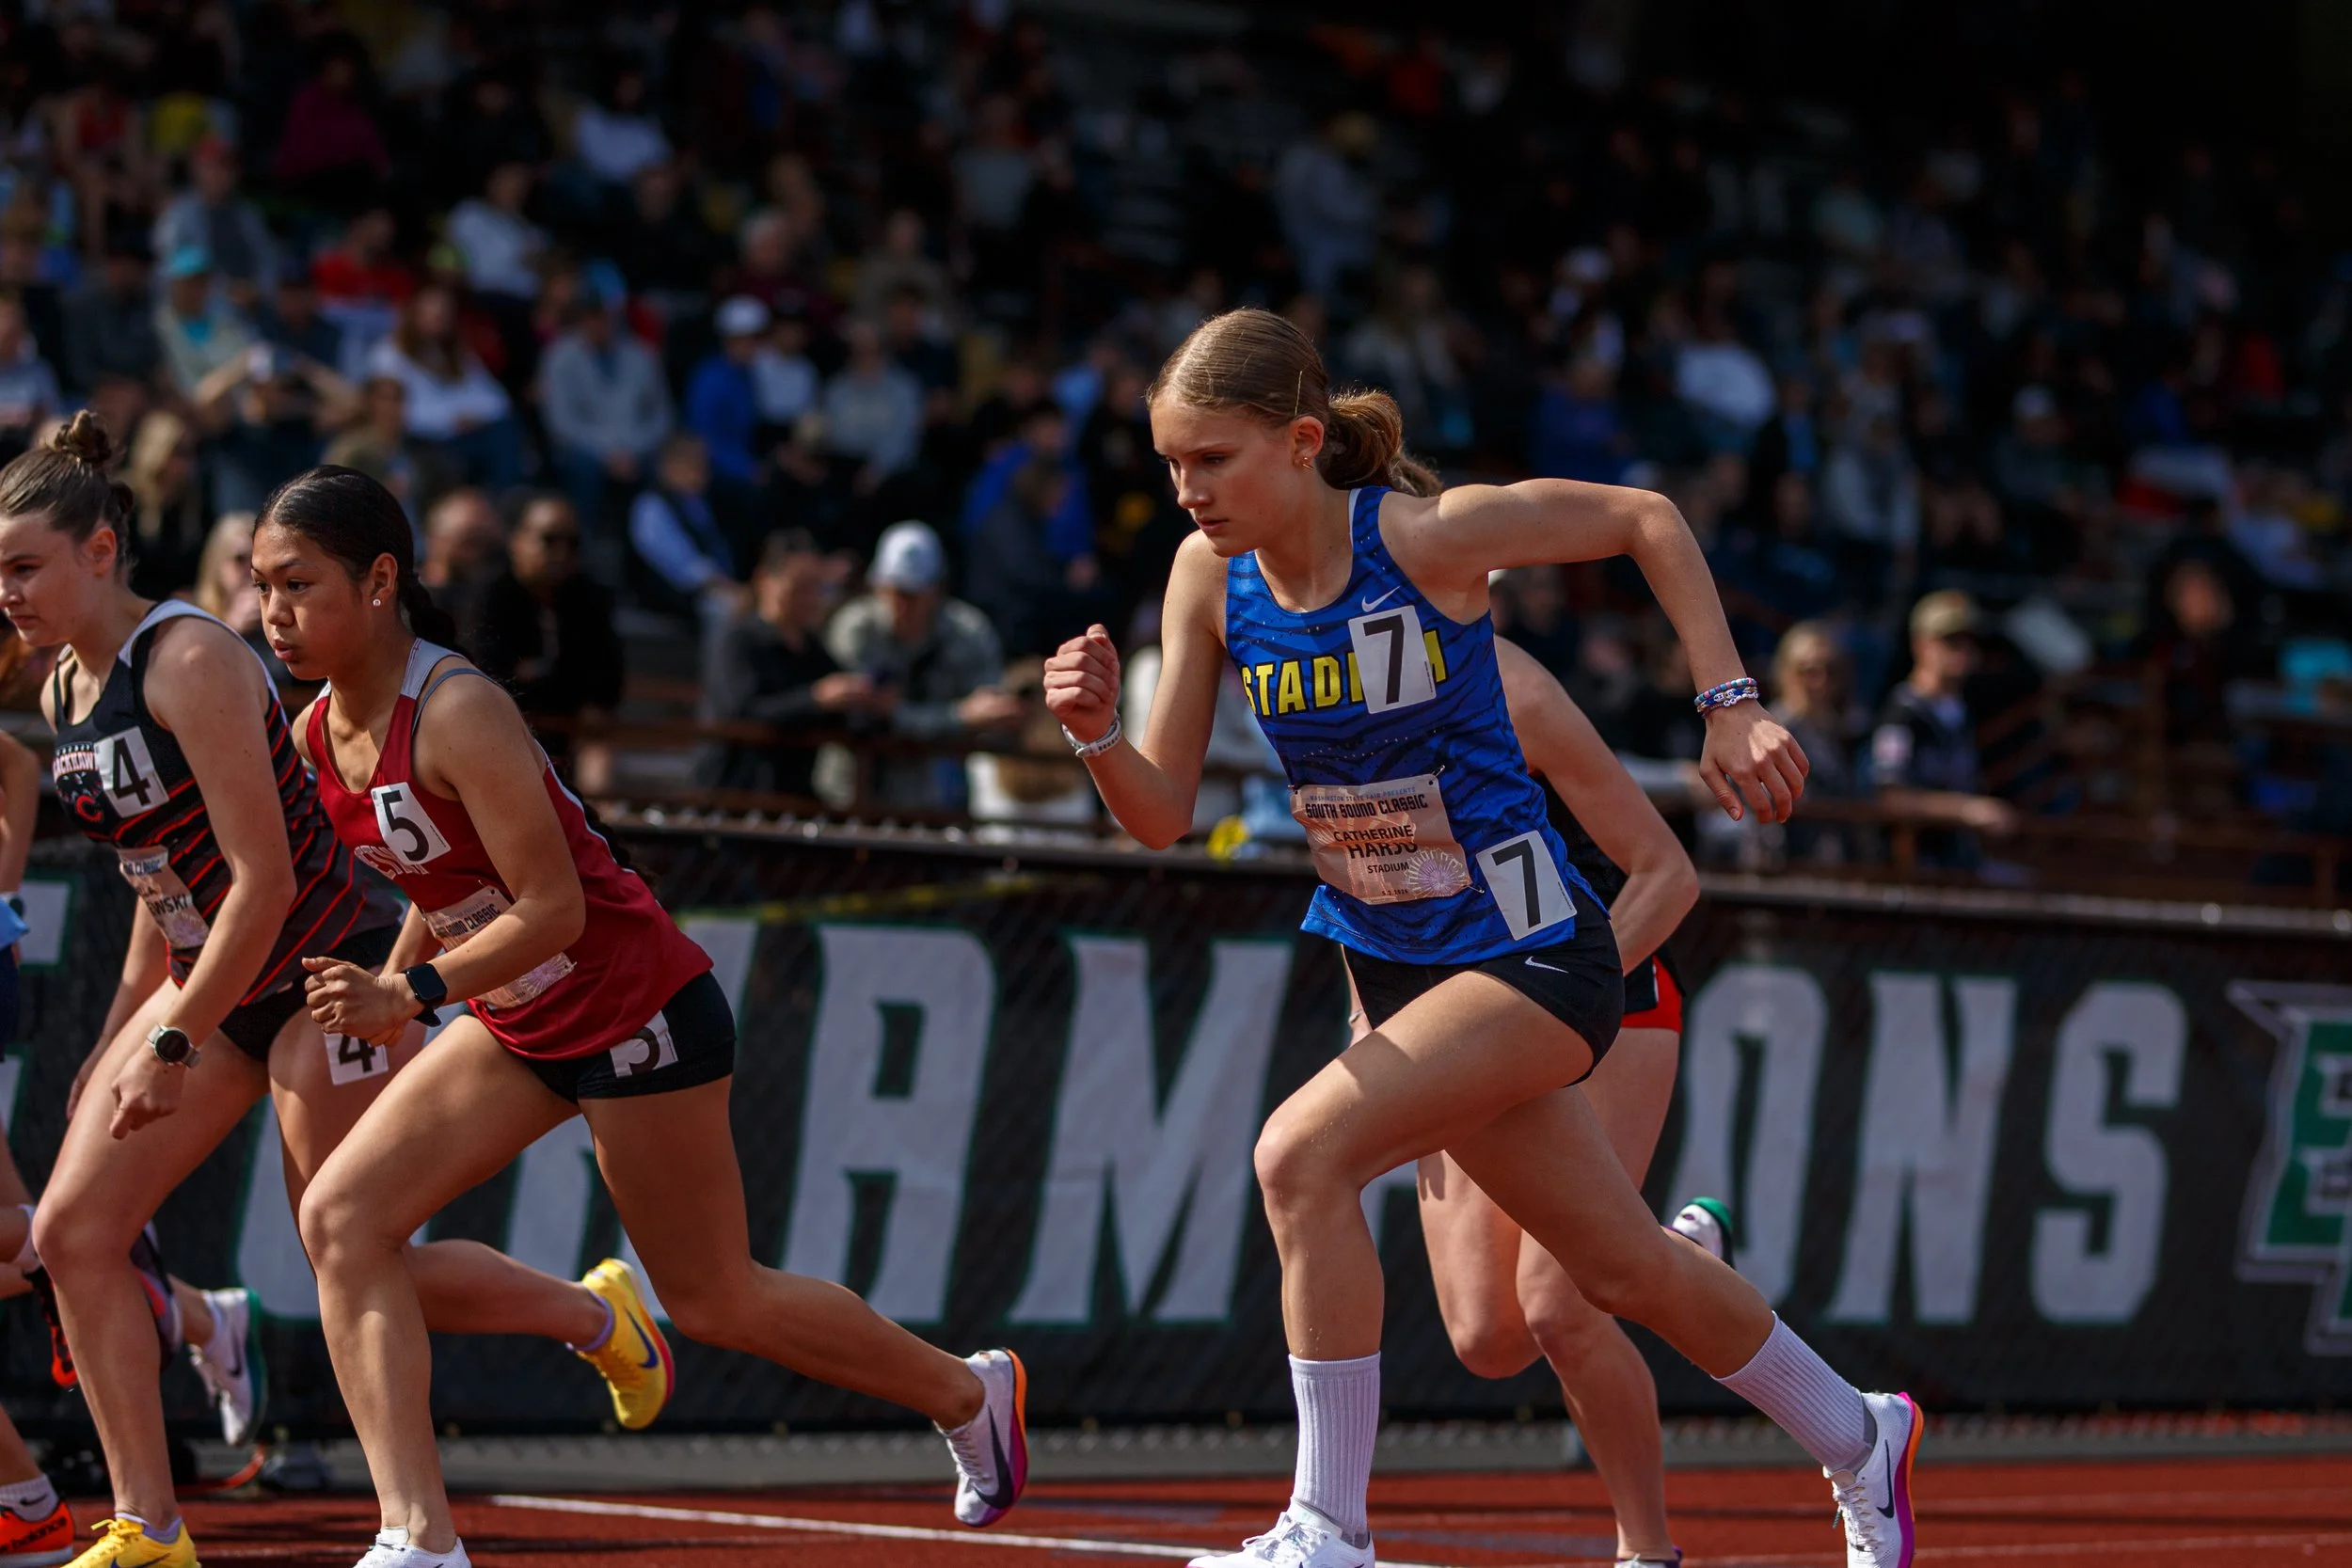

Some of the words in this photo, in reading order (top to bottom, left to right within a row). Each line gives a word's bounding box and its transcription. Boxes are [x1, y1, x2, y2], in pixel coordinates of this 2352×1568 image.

[1241, 628, 1448, 718] STADI
[1363, 614, 1405, 705] 7
[113, 737, 151, 806] 4
[381, 790, 430, 862] 5
[1305, 803, 1338, 818] SOUTH
[1340, 801, 1376, 818] SOUND
[1377, 794, 1428, 815] CLASSIC
[1333, 824, 1414, 843] CATHERINE
[1367, 862, 1409, 874] STADIUM
[1491, 839, 1541, 929] 7
[464, 903, 501, 930] CLASSIC
[339, 1034, 375, 1072] 4
